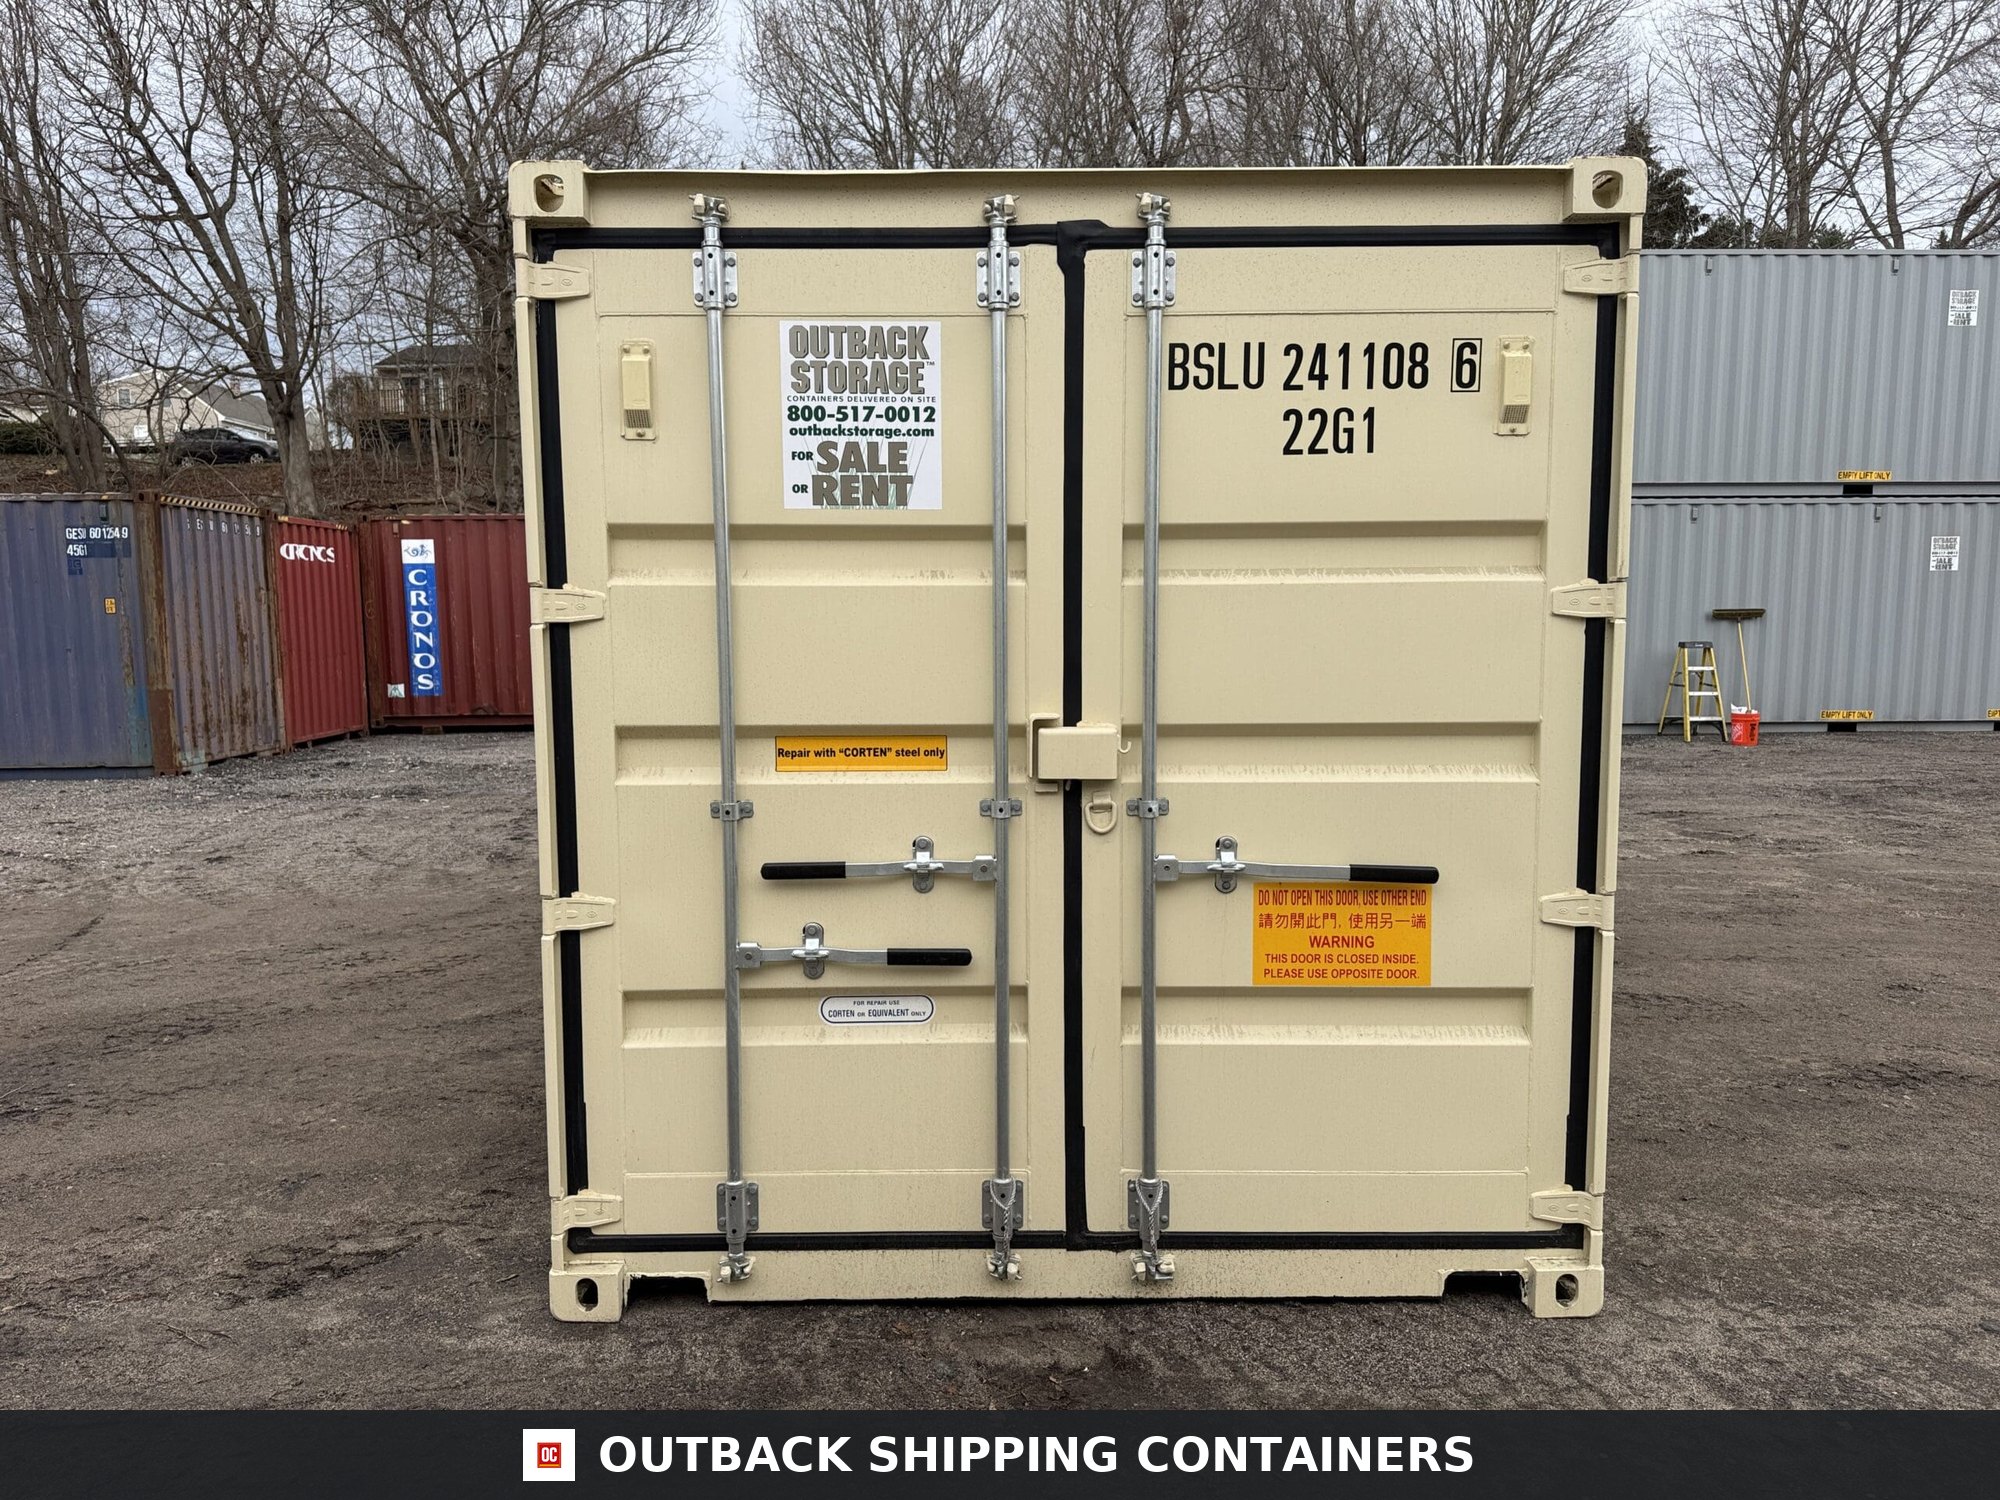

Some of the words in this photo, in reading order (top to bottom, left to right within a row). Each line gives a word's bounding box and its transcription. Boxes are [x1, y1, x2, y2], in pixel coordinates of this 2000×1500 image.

[788, 324, 930, 360] OUTBACK
[1168, 342, 1266, 390] BSLU
[1282, 342, 1429, 391] 241108
[1453, 340, 1480, 391] 6
[786, 395, 844, 403] CONTAINERS
[847, 395, 897, 403] DELIVERED
[787, 405, 936, 423] 800-517-0012
[789, 424, 935, 438] outbackstorage.com
[1282, 406, 1376, 455] 22G1
[791, 451, 813, 461] FOR
[816, 440, 908, 473] SALE
[792, 484, 808, 493] OR
[812, 475, 914, 506] RENT
[66, 544, 88, 557] 45G1
[407, 569, 436, 690] CRONOS
[777, 748, 810, 760] Repair
[814, 747, 836, 757] with
[895, 747, 920, 757] steel
[923, 747, 945, 758] only
[1258, 889, 1270, 906] DO
[1273, 889, 1288, 906] NOT
[1291, 889, 1312, 906] OPEN
[1315, 889, 1333, 906] THIS
[1363, 889, 1379, 906] USE
[1381, 889, 1408, 906] OTHER
[1411, 889, 1426, 906] END
[1309, 935, 1375, 948] WARNING
[1265, 953, 1288, 964] THIS
[1291, 953, 1321, 964] DOOR
[1324, 953, 1334, 964] IS
[1337, 953, 1379, 964] CLOSED
[1382, 953, 1419, 964] INSIDE.
[1264, 968, 1304, 979] PLEASE
[1307, 968, 1328, 979] USE
[1331, 968, 1383, 979] OPPOSITE
[1386, 968, 1420, 979] DOOR.
[828, 1010, 855, 1018] CORTEN
[868, 1009, 909, 1017] EQUIVALENT
